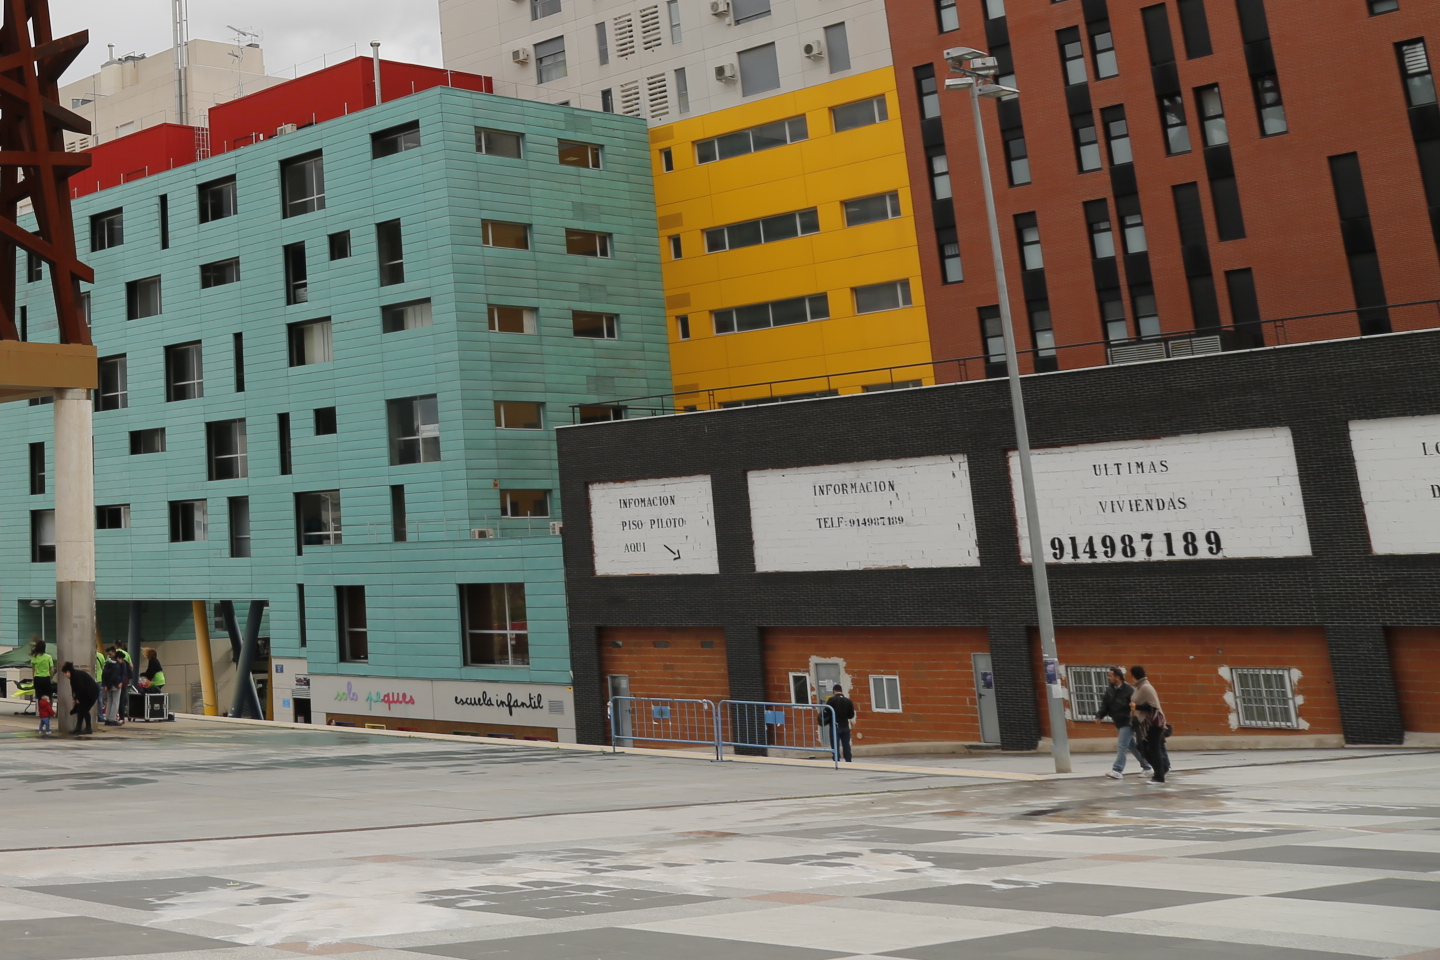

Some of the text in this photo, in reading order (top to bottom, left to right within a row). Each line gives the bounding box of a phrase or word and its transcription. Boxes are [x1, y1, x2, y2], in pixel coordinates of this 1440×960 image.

[1092, 460, 1170, 477] ULTIMAS
[813, 480, 896, 497] INFORMACION
[618, 495, 676, 509] INFOMACION
[1098, 496, 1188, 513] VIVIENDAS
[621, 517, 685, 531] PISO PILOTO
[624, 542, 647, 553] AQUI
[1050, 530, 1223, 560] 914987189
[334, 681, 359, 702] solo
[365, 690, 416, 711] peques
[454, 690, 544, 717] escuela infantil
